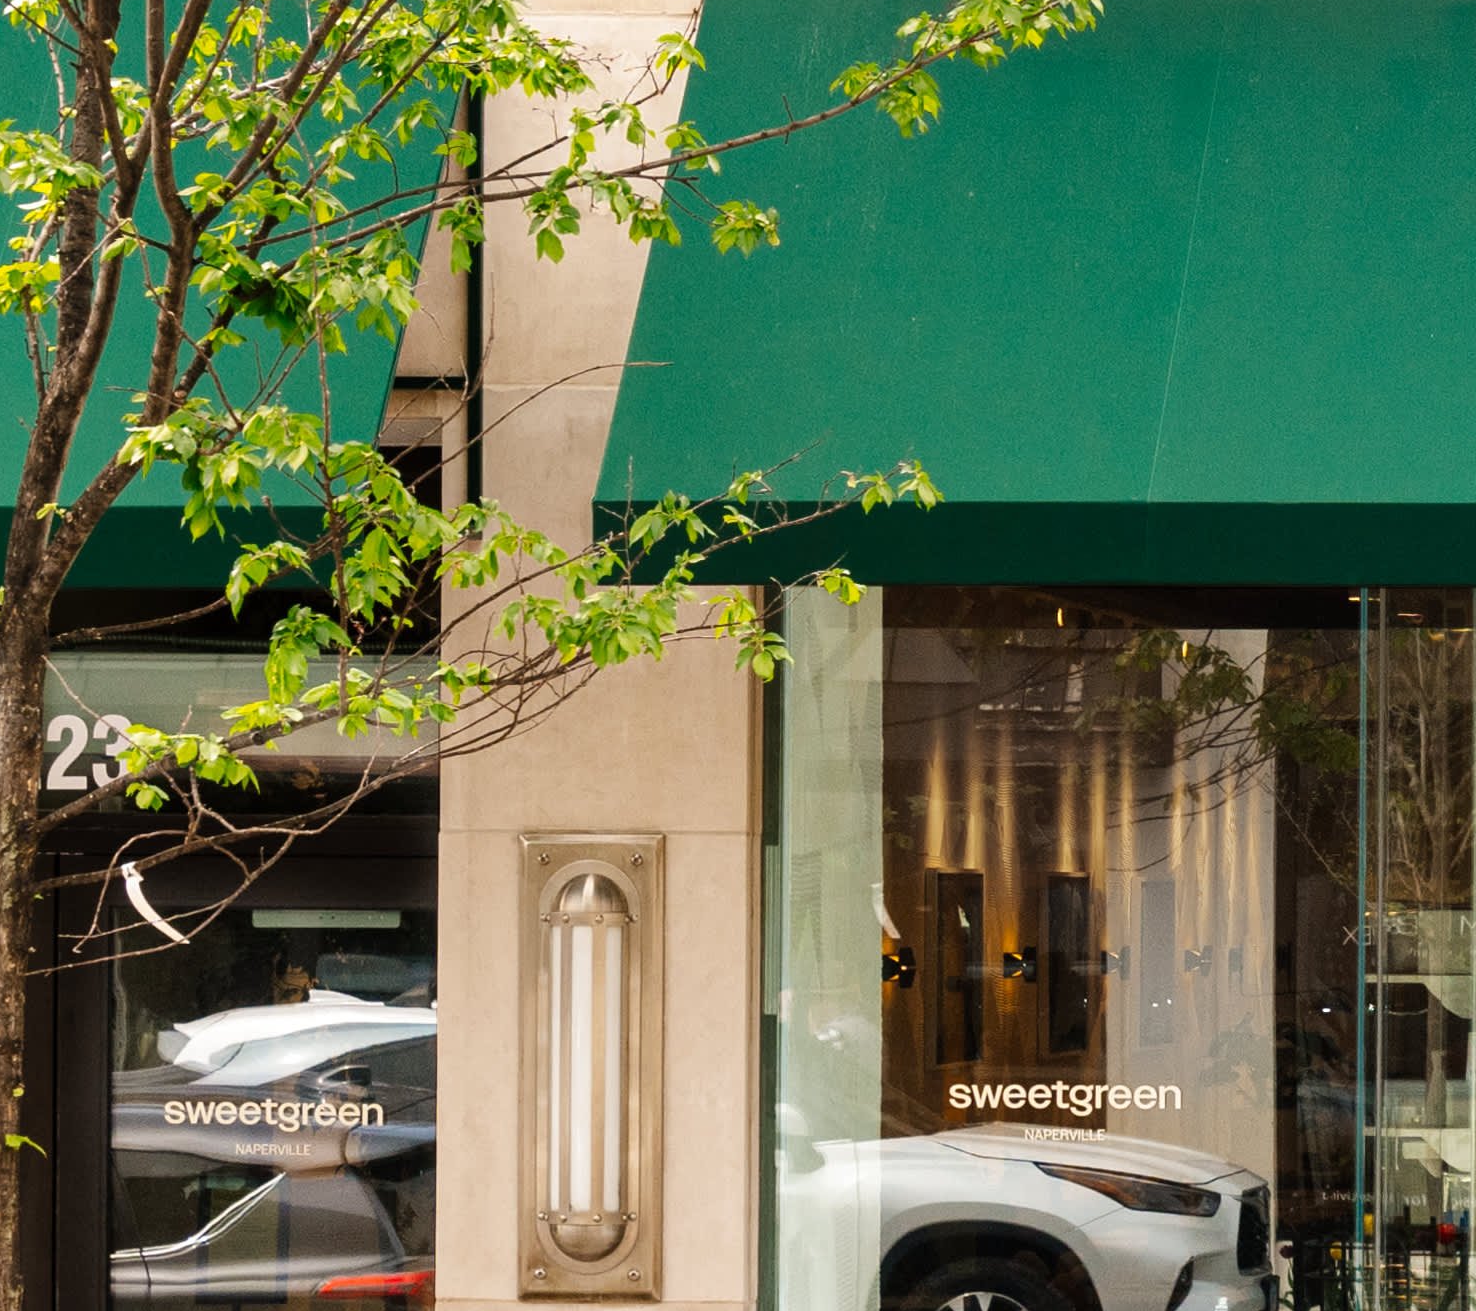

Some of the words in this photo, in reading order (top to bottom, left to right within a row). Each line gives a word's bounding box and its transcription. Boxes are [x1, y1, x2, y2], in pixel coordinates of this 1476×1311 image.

[38, 714, 132, 790] 23
[164, 1097, 384, 1133] sweetgreen
[948, 1079, 1182, 1117] sweetgreen
[235, 1144, 312, 1156] NAPERVILLE
[1024, 1128, 1106, 1142] NAPERVILLE
